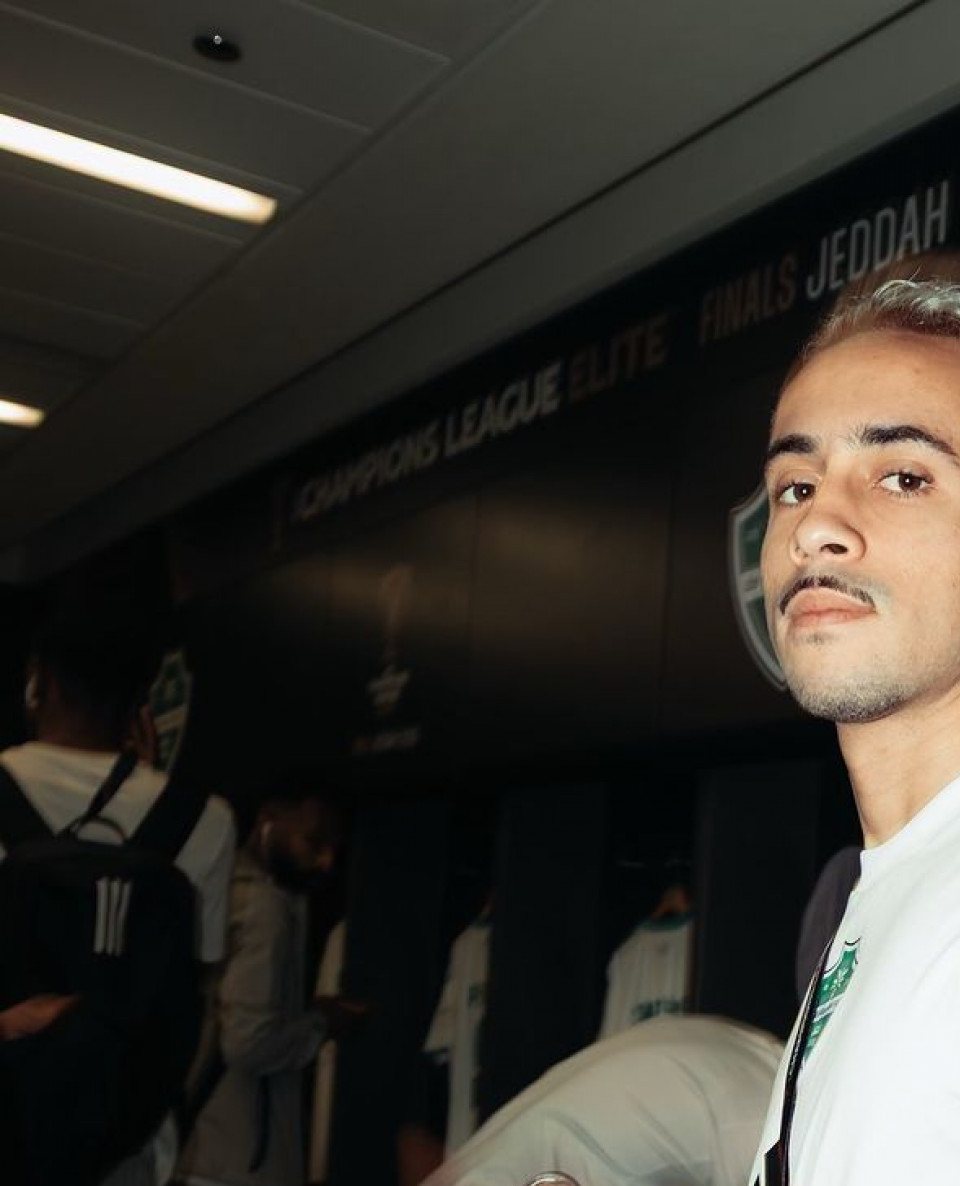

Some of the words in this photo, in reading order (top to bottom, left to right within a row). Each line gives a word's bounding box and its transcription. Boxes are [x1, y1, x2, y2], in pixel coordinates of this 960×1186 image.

[293, 419, 441, 522] CHAMPIONS
[444, 358, 563, 458] LEAGUE
[568, 313, 668, 402] ELITE
[698, 253, 798, 346] FINALS
[806, 179, 949, 301] JEDDAH
